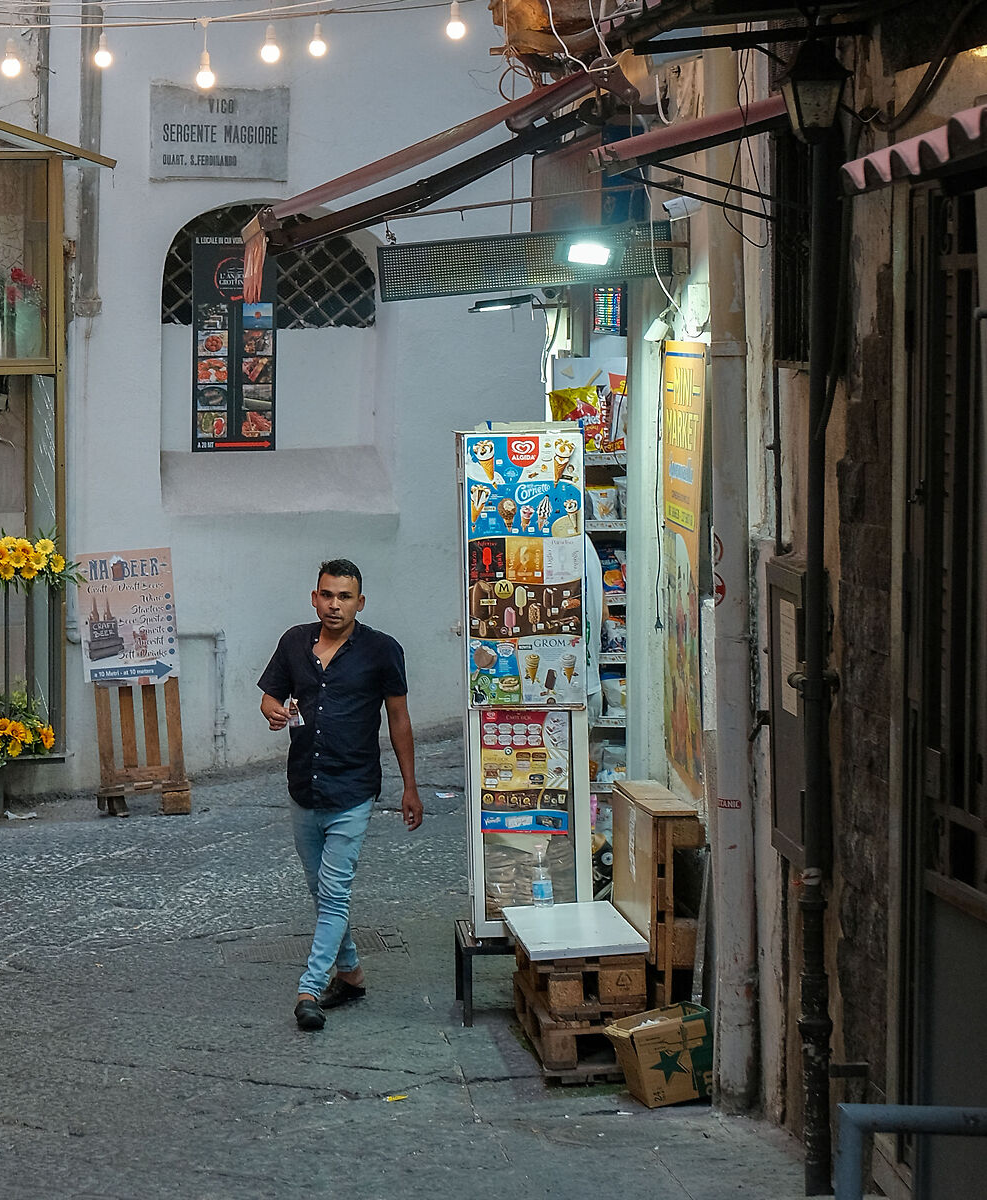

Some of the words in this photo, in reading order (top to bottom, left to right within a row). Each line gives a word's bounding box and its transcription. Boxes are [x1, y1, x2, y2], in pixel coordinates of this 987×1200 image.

[207, 98, 234, 113] VICO
[162, 123, 217, 143] SERGENTE
[223, 125, 278, 144] MAGGIORE
[162, 154, 187, 166] QUART.
[201, 236, 218, 244] LOCALE
[673, 367, 693, 407] MINI
[666, 408, 699, 451] MARKET
[515, 484, 550, 505] Cornetto
[122, 557, 159, 578] BEER
[499, 583, 509, 592] M
[92, 622, 115, 631] CRAFT
[93, 630, 115, 638] BEER
[533, 639, 566, 648] GROM
